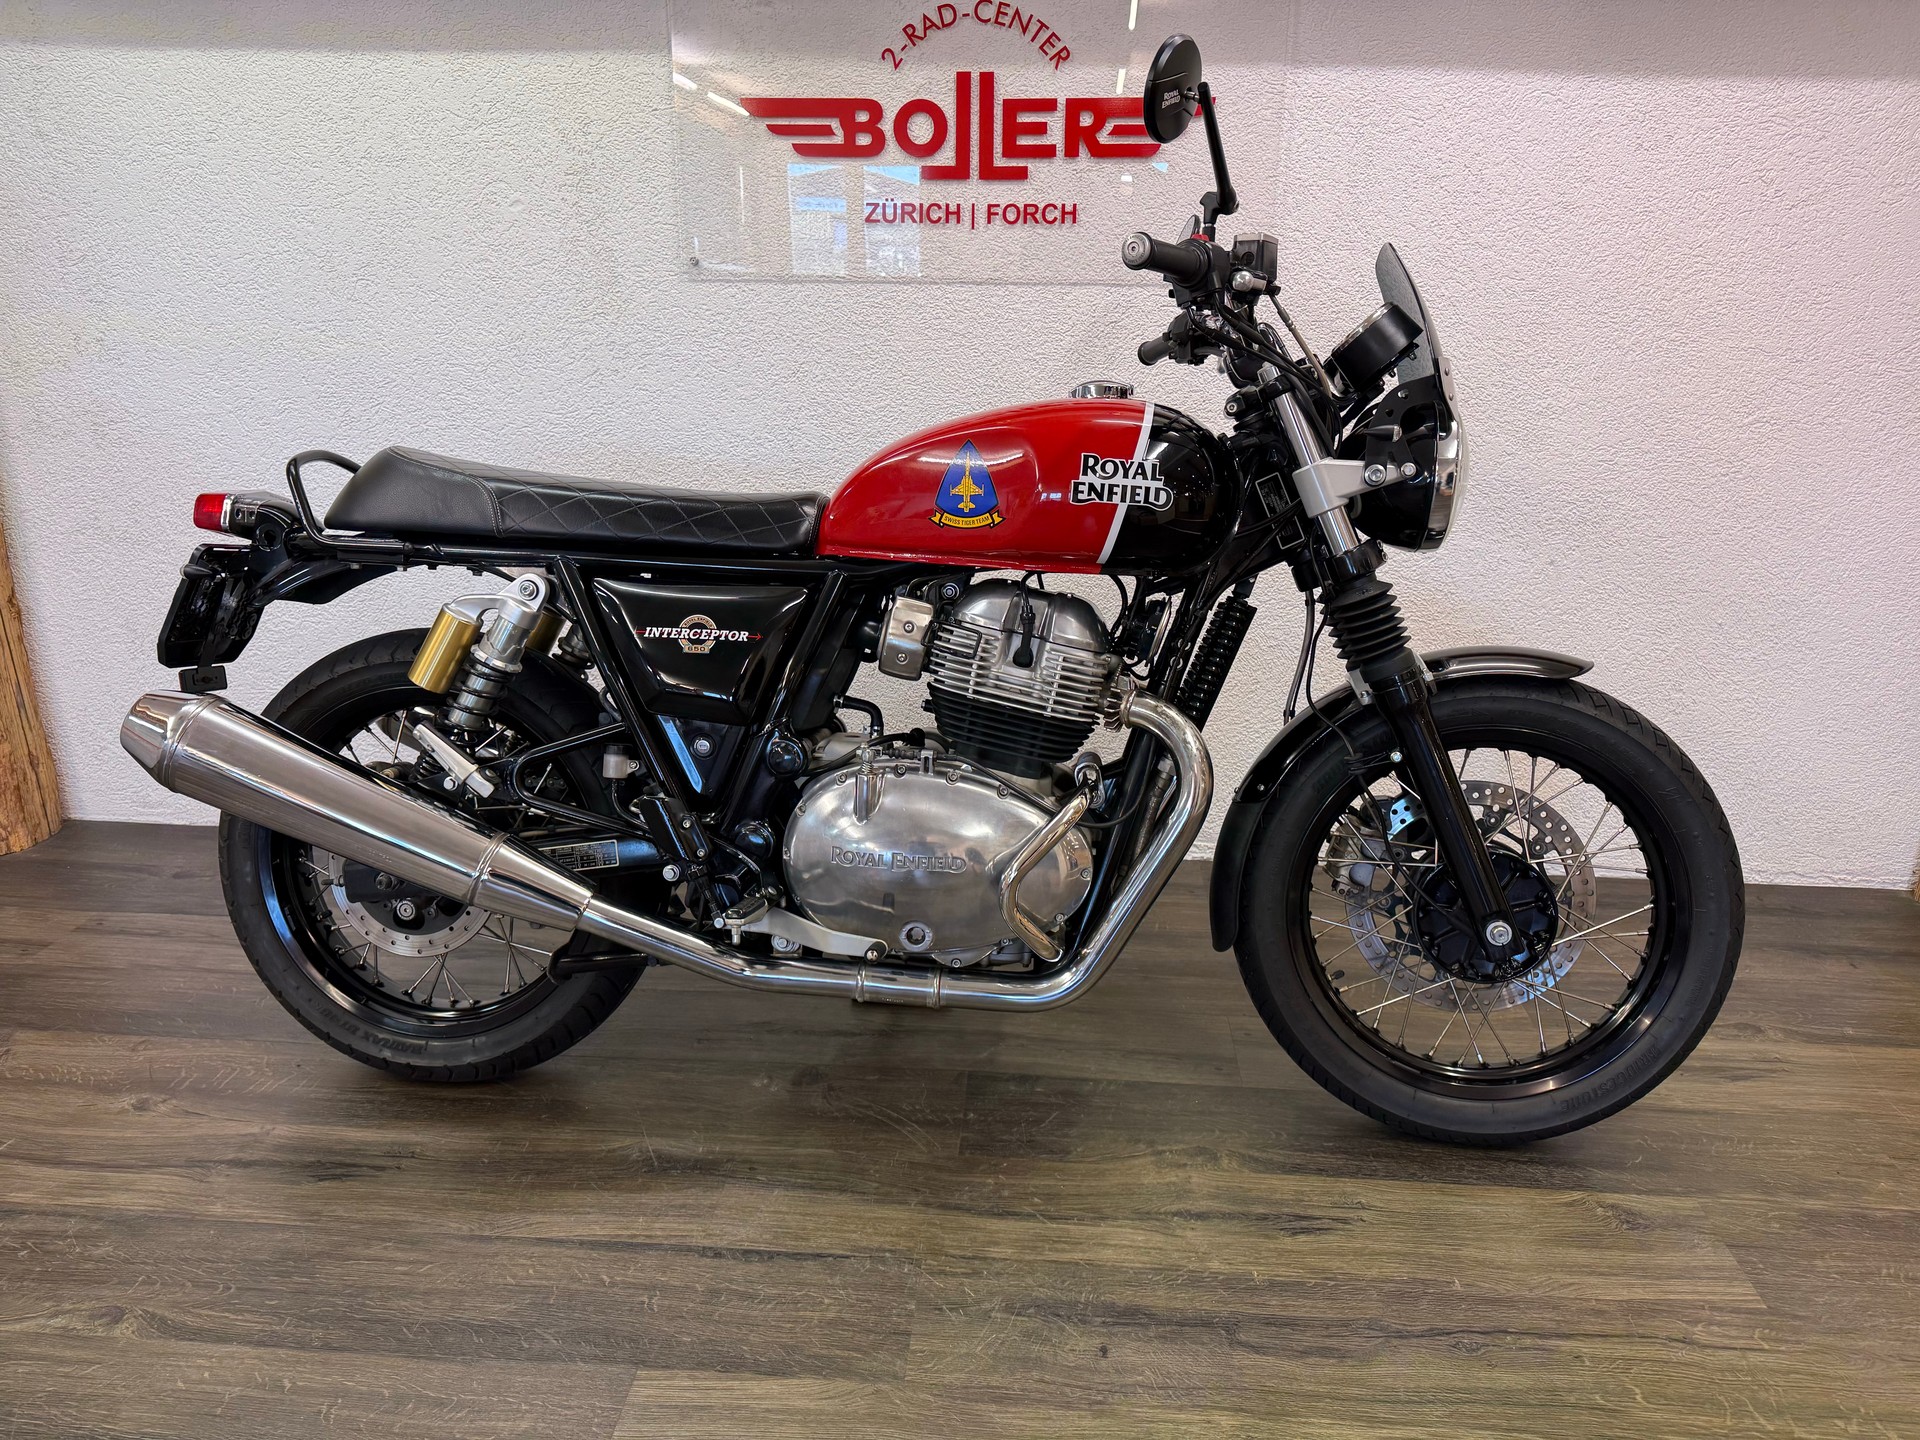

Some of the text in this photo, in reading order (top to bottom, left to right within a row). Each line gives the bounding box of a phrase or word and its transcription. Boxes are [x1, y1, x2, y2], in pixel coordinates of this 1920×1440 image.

[880, 0, 1072, 71] 2-RAD-CENTER
[1162, 96, 1180, 108] ENFIELD
[1164, 90, 1178, 100] ROYAL
[838, 71, 1112, 180] BOLLER
[864, 198, 962, 225] ZÜRICH
[986, 203, 1078, 225] FORCH
[1081, 453, 1164, 483] ROYAL
[1070, 480, 1174, 511] ENFIELD
[944, 516, 961, 525] SWISS
[976, 516, 990, 525] TEAM
[643, 627, 749, 642] INTERCEPTOR
[831, 846, 967, 874] ROYAL ENFIELD
